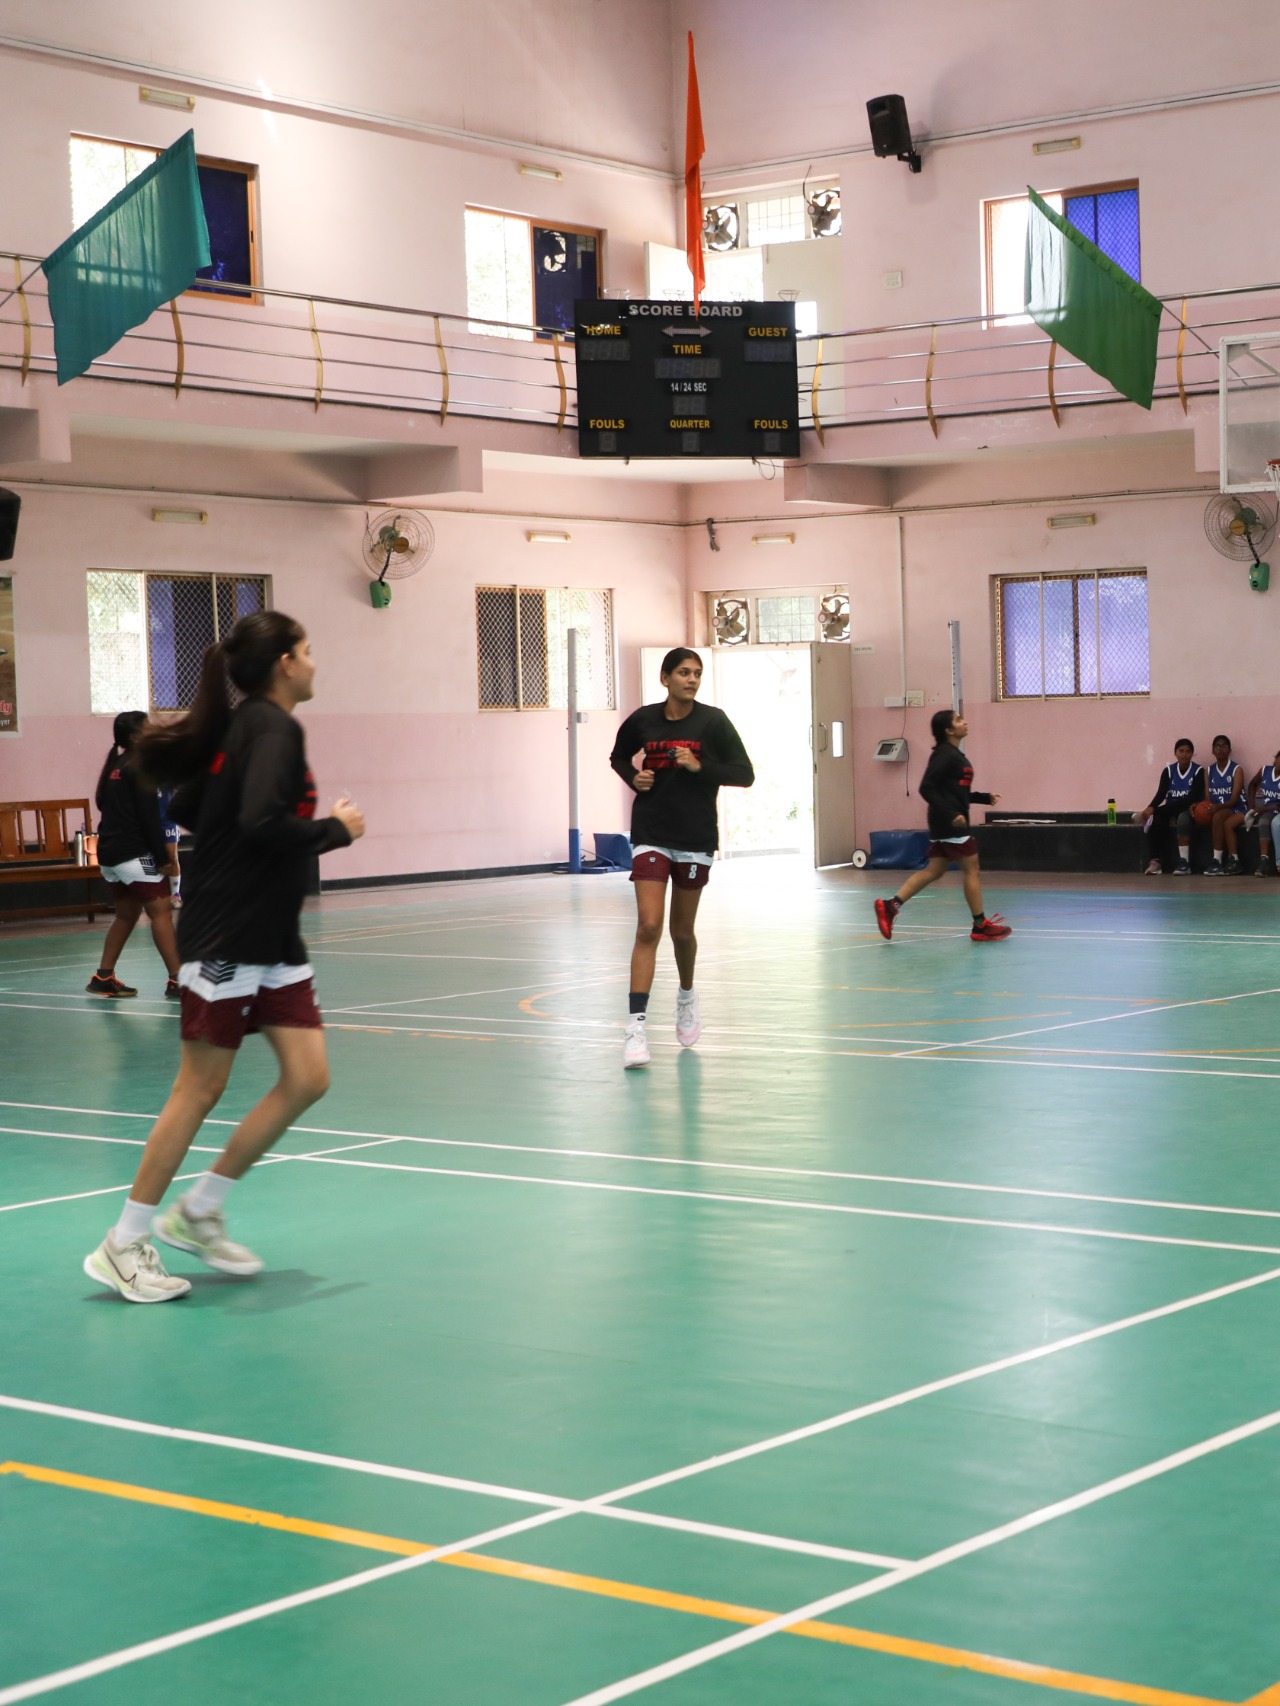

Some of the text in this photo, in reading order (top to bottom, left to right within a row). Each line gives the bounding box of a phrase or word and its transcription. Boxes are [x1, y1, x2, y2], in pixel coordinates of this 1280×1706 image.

[628, 305, 743, 317] SCORE BOARD
[586, 326, 622, 336] HOME
[748, 327, 788, 337] GUEST
[673, 344, 702, 354] TIME
[694, 382, 708, 392] SEC
[590, 420, 625, 429] FOULS
[670, 420, 710, 429] QUARTER
[754, 420, 788, 429] FOULS
